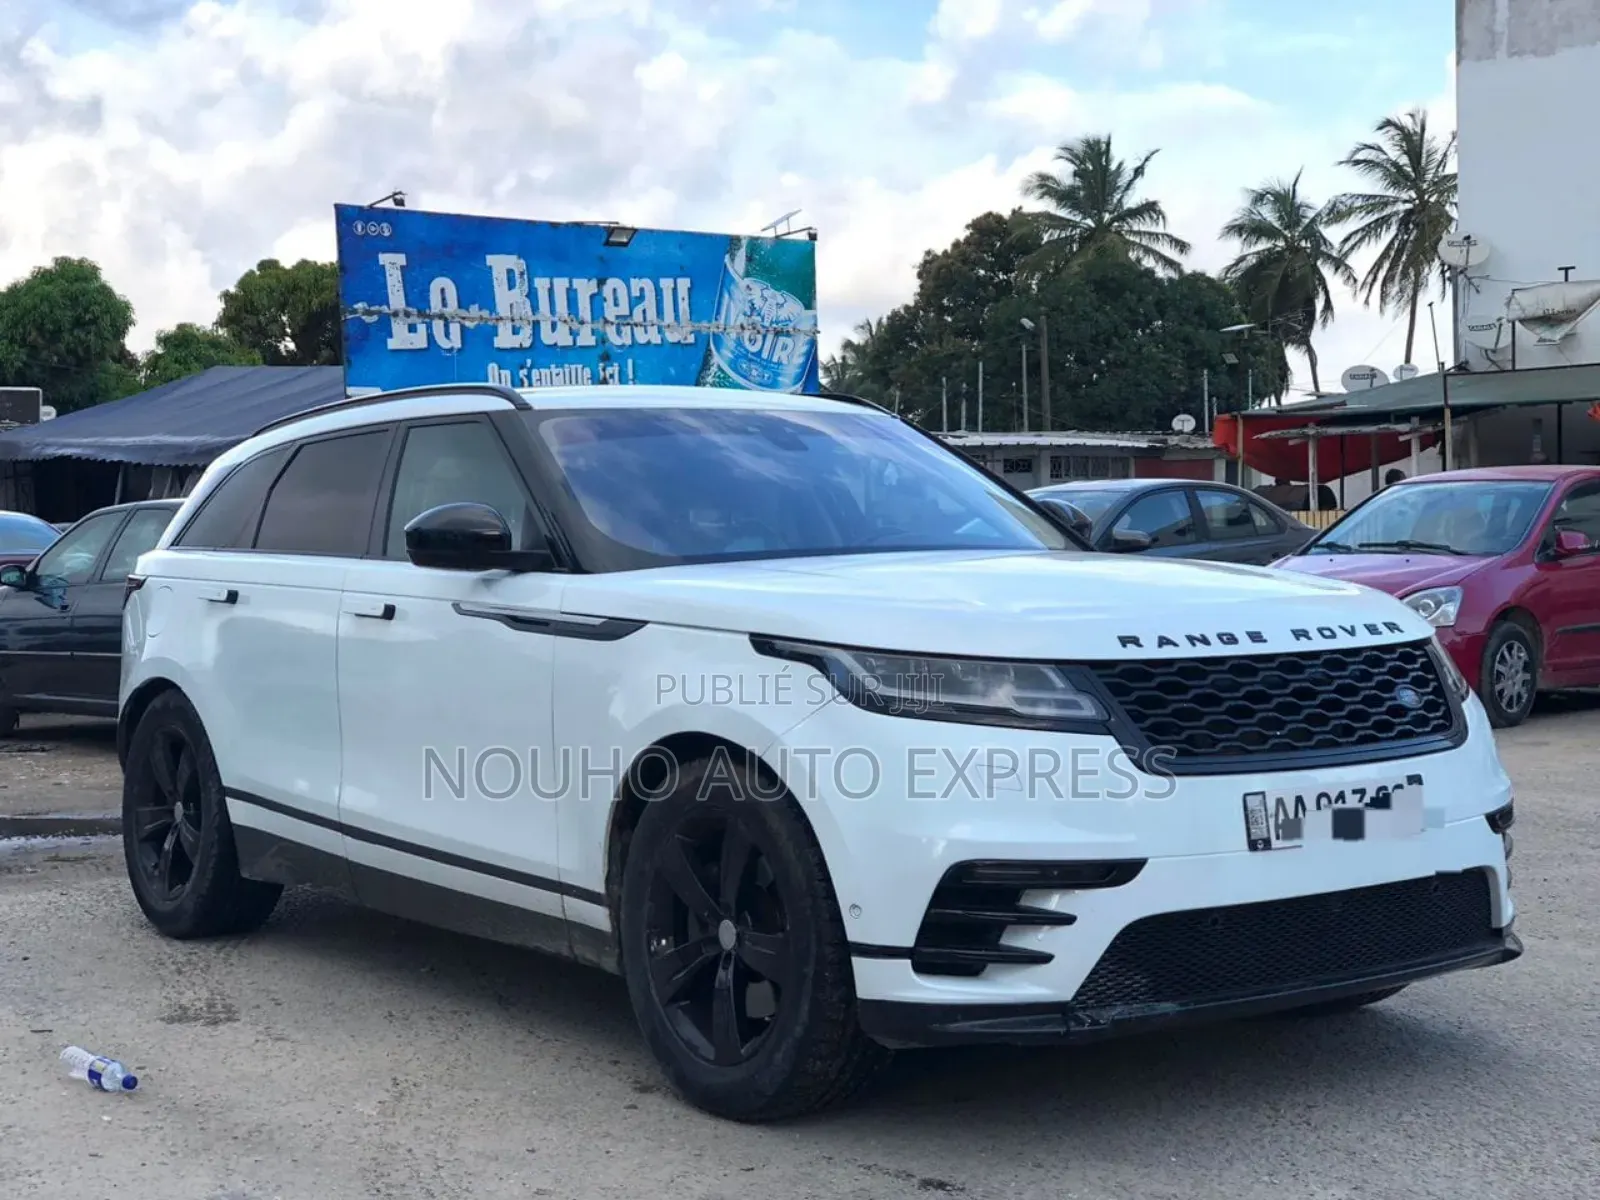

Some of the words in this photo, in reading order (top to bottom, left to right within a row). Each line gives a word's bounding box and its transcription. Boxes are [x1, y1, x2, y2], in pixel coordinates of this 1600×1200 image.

[378, 252, 463, 351] Le
[486, 254, 696, 349] Bureau
[487, 362, 511, 387] On
[1117, 630, 1268, 649] RANGE
[1290, 621, 1405, 641] ROVER
